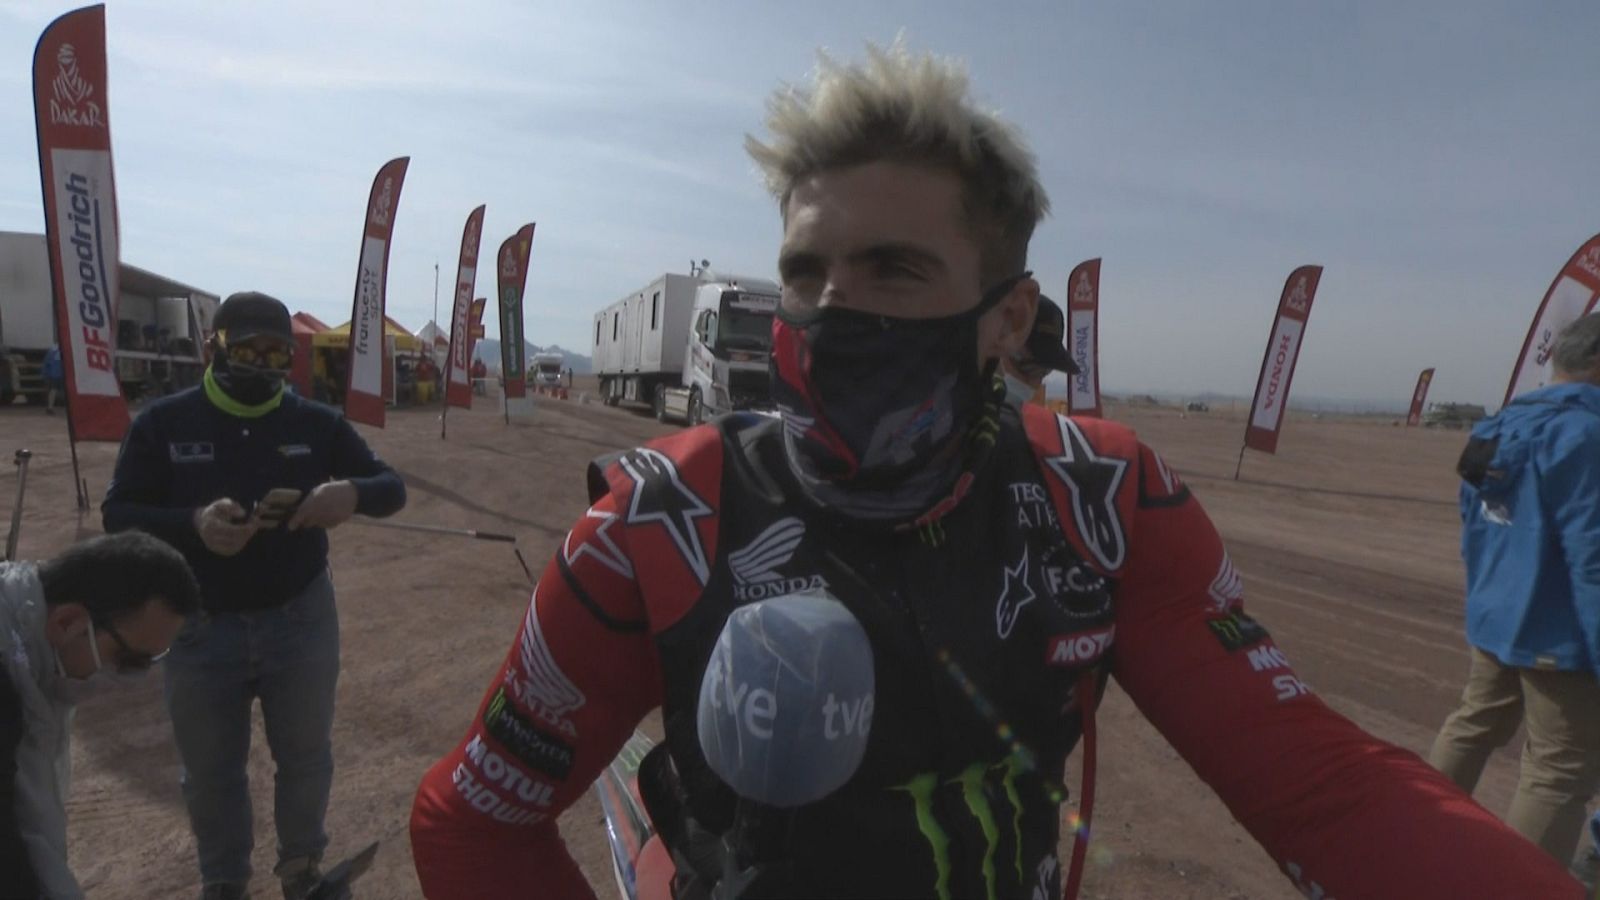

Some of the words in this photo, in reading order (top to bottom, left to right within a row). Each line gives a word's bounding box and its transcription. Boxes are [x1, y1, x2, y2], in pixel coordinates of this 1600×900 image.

[49, 98, 105, 127] DAKAR
[65, 171, 112, 372] BFGoodrich
[455, 289, 471, 368] MOTUL
[1264, 334, 1291, 411] HONDA
[733, 574, 831, 601] HONDA
[711, 660, 778, 740] tve
[821, 692, 874, 740] tve
[465, 733, 555, 806] MOTUL
